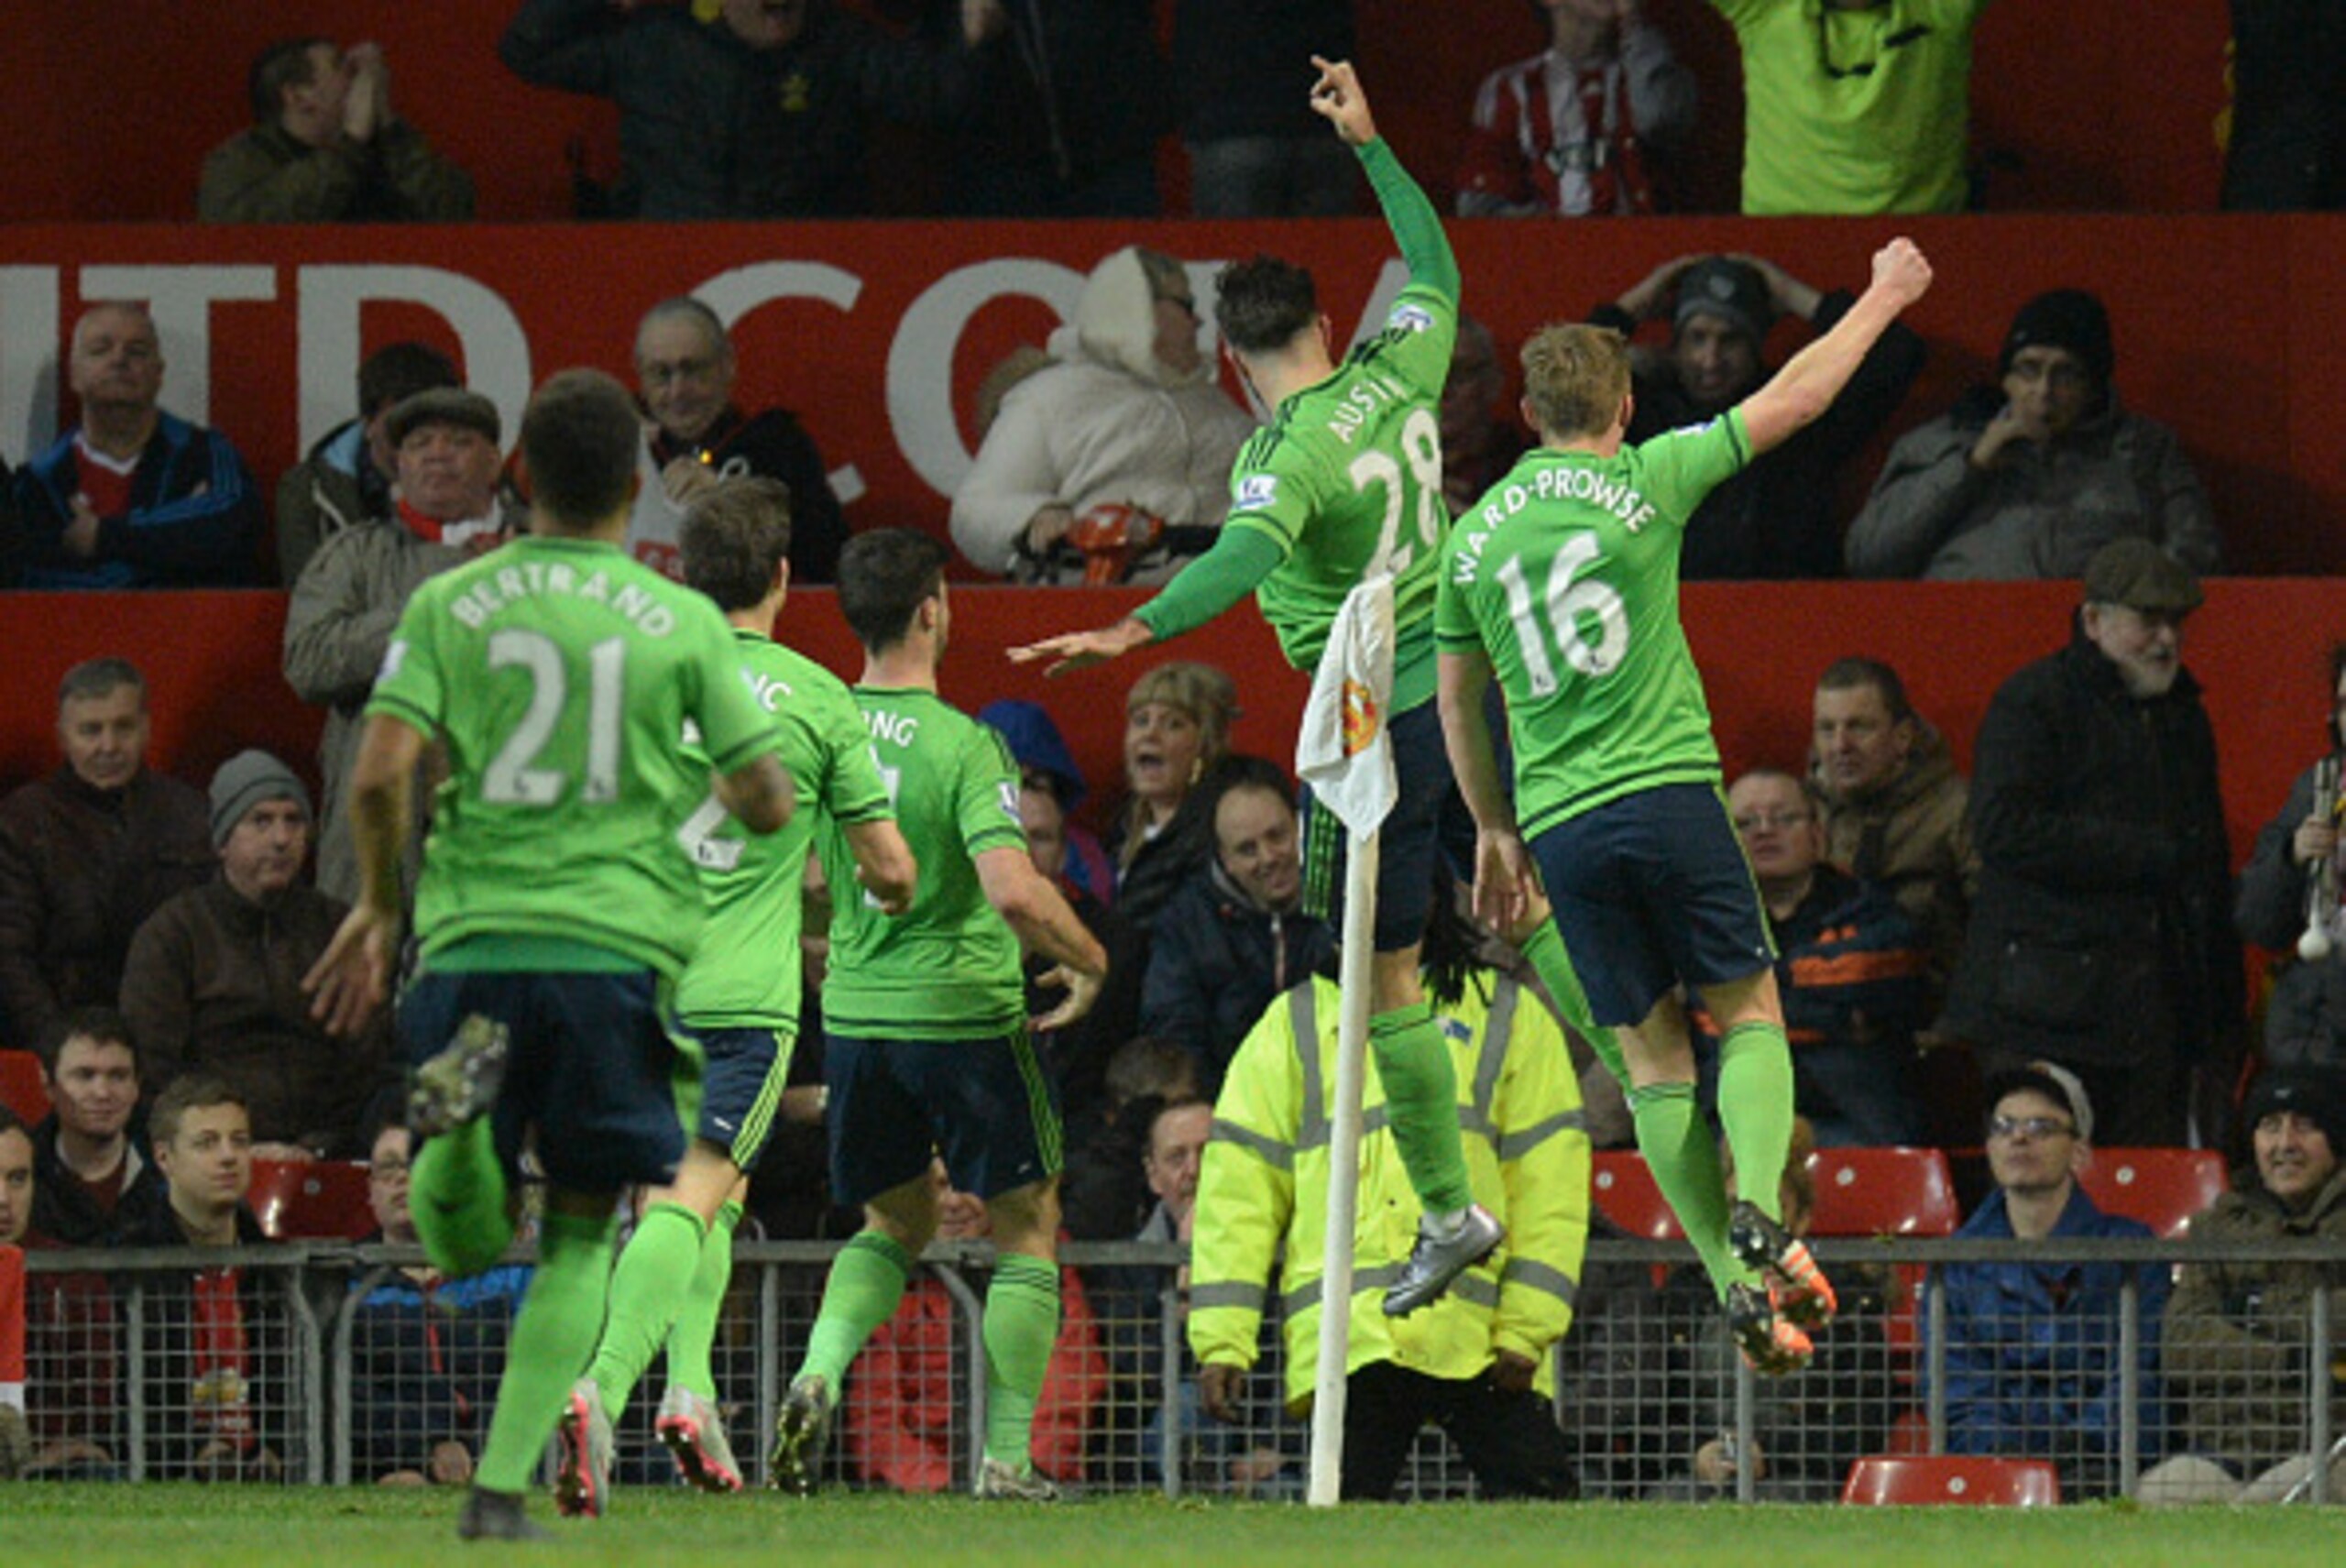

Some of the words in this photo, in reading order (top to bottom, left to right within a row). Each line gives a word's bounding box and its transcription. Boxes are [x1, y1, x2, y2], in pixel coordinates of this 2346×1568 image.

[1349, 407, 1443, 583] 28
[1453, 467, 1656, 584] WARD-PROWSE
[449, 562, 675, 639] BERTRAND
[1495, 530, 1630, 699] 16
[481, 627, 625, 806] 21
